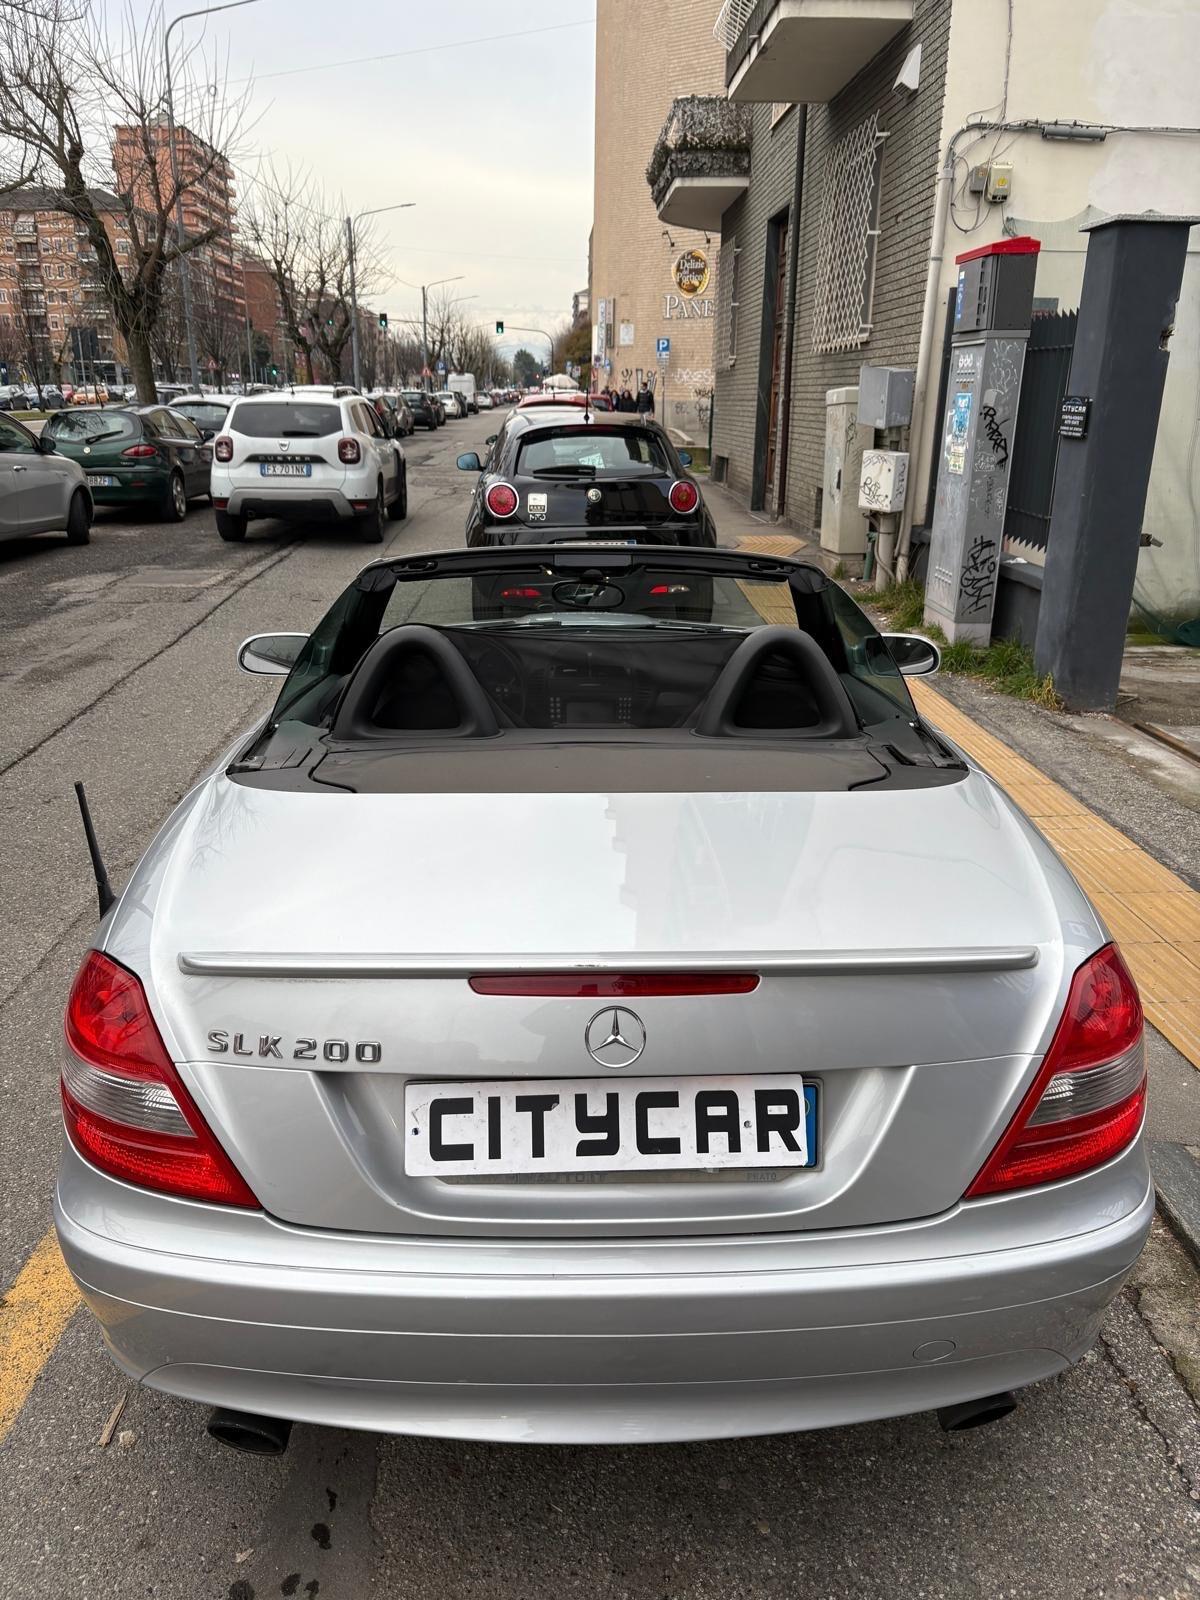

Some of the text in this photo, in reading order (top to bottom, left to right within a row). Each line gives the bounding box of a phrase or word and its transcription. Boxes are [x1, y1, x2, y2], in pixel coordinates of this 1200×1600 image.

[680, 259, 705, 269] Delizie
[677, 272, 703, 282] Portico
[664, 295, 714, 319] PANE
[659, 340, 668, 351] P
[207, 1030, 382, 1063] SLK 200
[429, 1089, 802, 1161] CITYCAR
